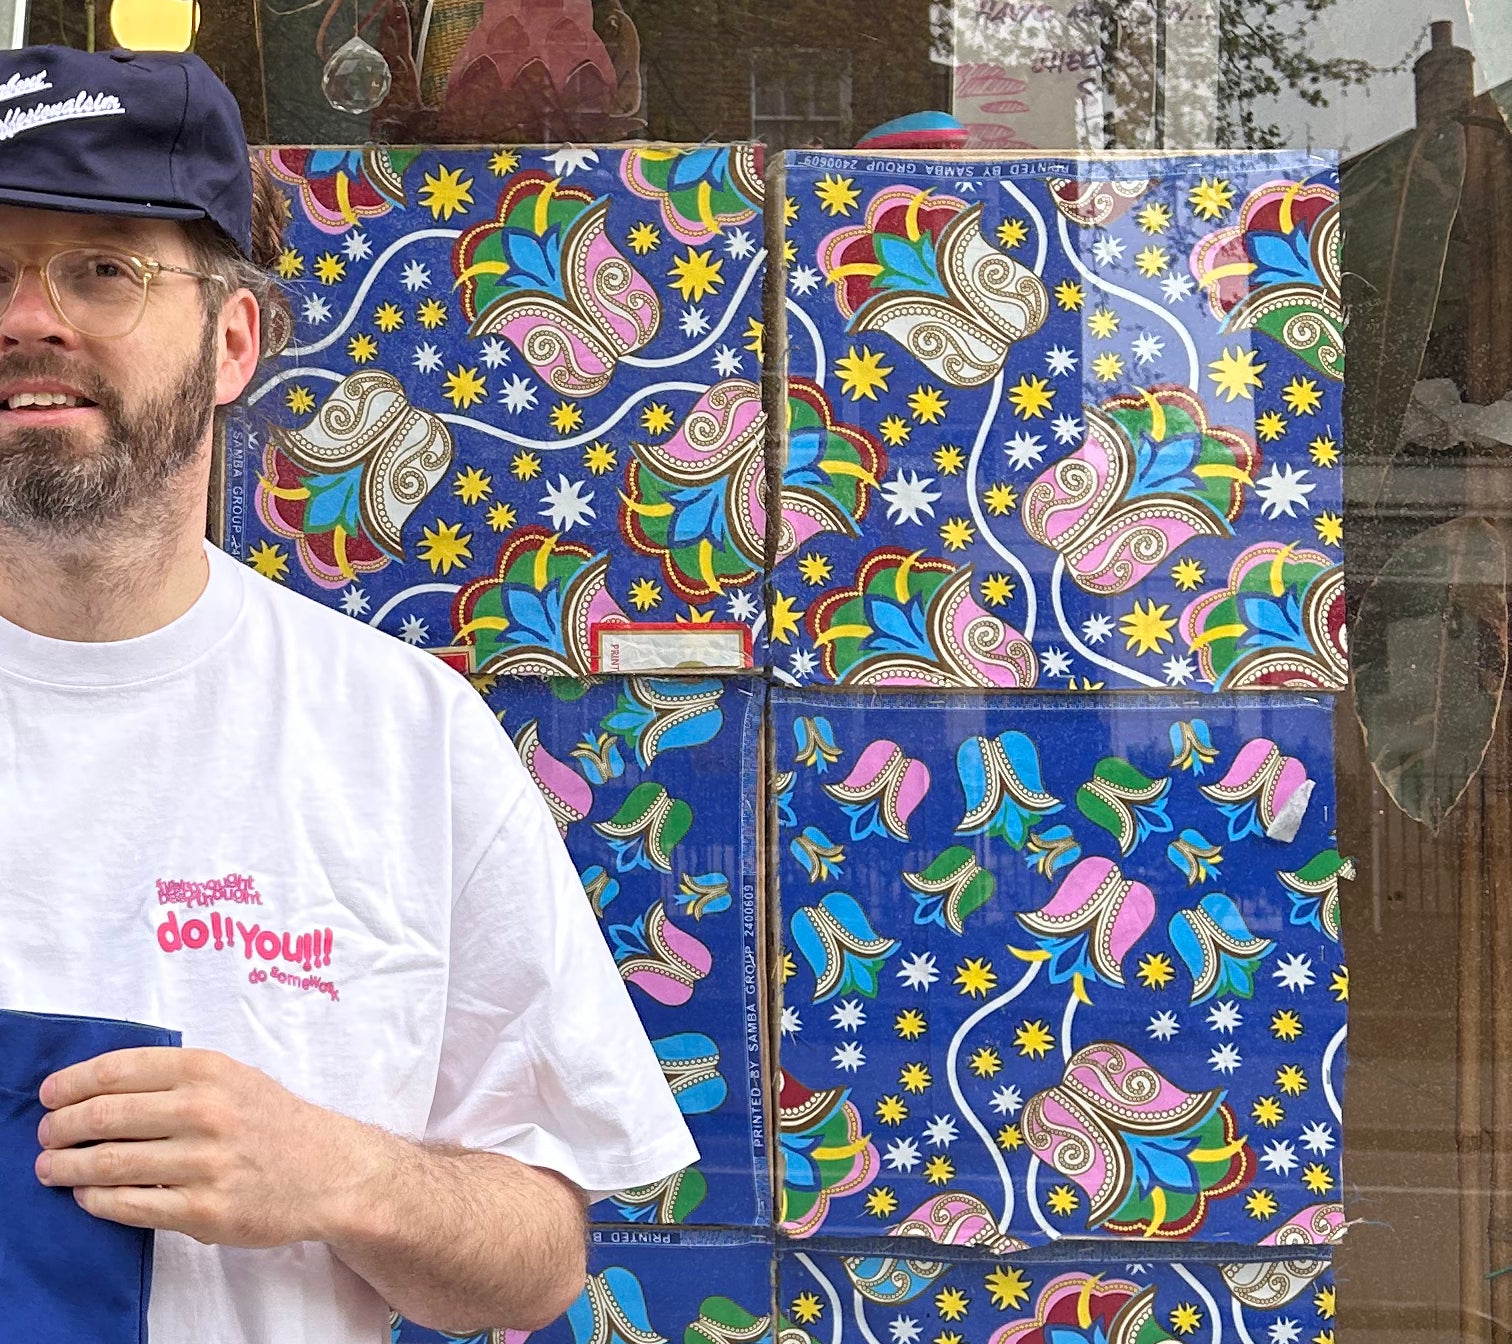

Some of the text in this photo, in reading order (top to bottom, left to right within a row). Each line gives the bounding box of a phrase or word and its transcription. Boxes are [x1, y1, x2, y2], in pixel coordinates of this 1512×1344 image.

[866, 161, 917, 174] GROUP
[925, 164, 975, 177] SAMBA
[983, 166, 1002, 178] BY
[1009, 162, 1070, 175] PRINTED
[232, 431, 243, 478] SAMBA
[231, 486, 243, 534] GROUP
[157, 910, 235, 953] do!!
[248, 967, 268, 985] do
[743, 885, 764, 1148] PRINTED BY SAMBA GROUP 2400609
[610, 1231, 672, 1244] PRINTED
